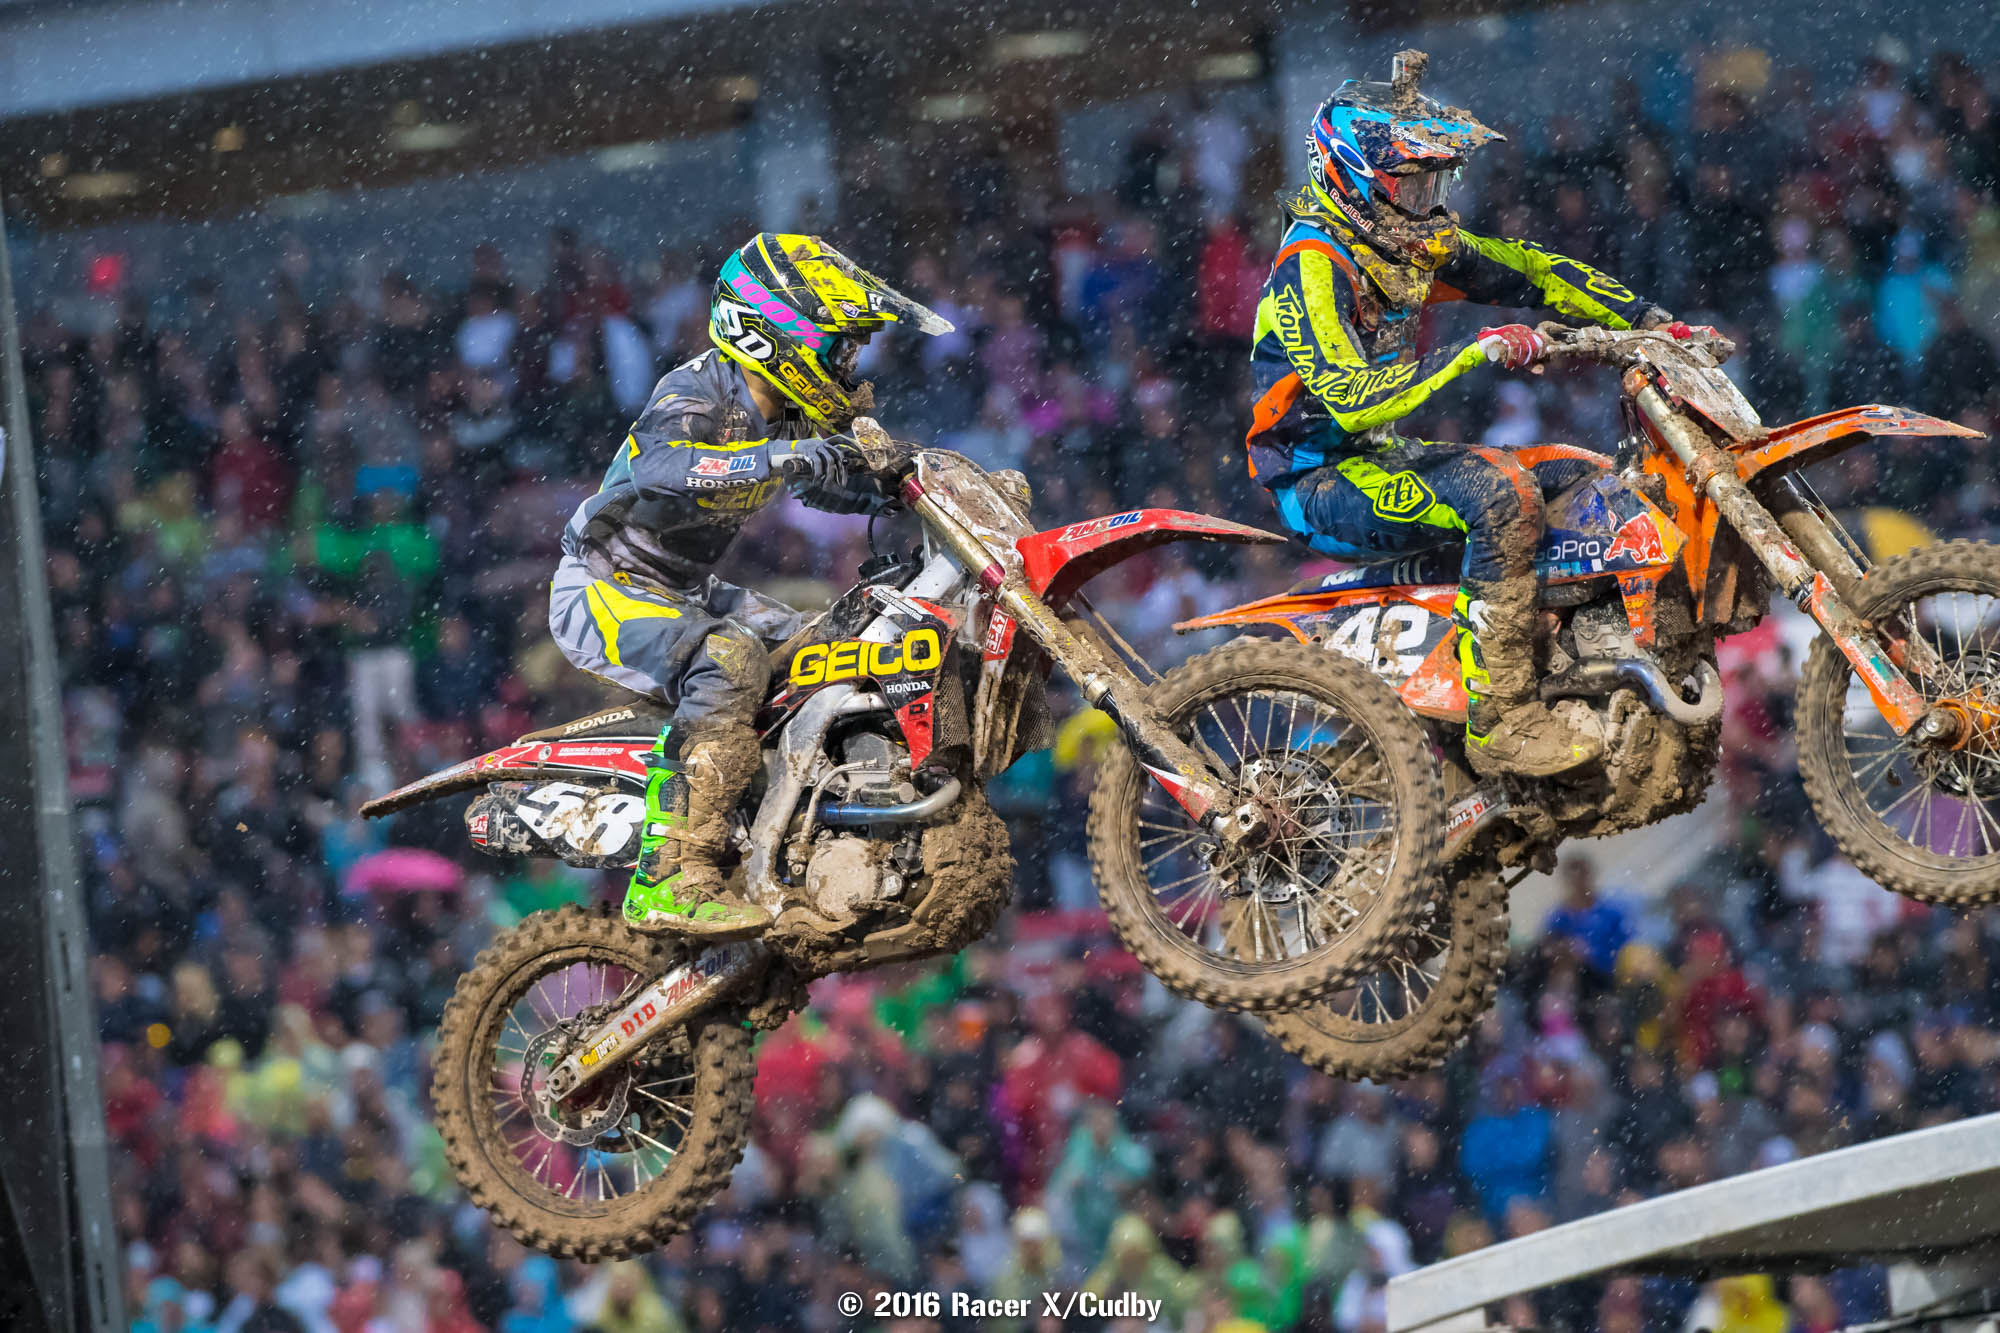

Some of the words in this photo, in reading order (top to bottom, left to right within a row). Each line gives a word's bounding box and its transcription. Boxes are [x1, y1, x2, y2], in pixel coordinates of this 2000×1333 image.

[1330, 188, 1354, 215] Red
[1350, 207, 1375, 233] Bull
[730, 271, 829, 349] 100%
[778, 361, 836, 415] GEICO
[686, 477, 760, 489] HONDA
[1322, 567, 1368, 587] KTM
[789, 628, 941, 686] GEICO
[1323, 604, 1430, 677] 42
[886, 680, 931, 695] HONDA
[564, 709, 636, 735] HONDA
